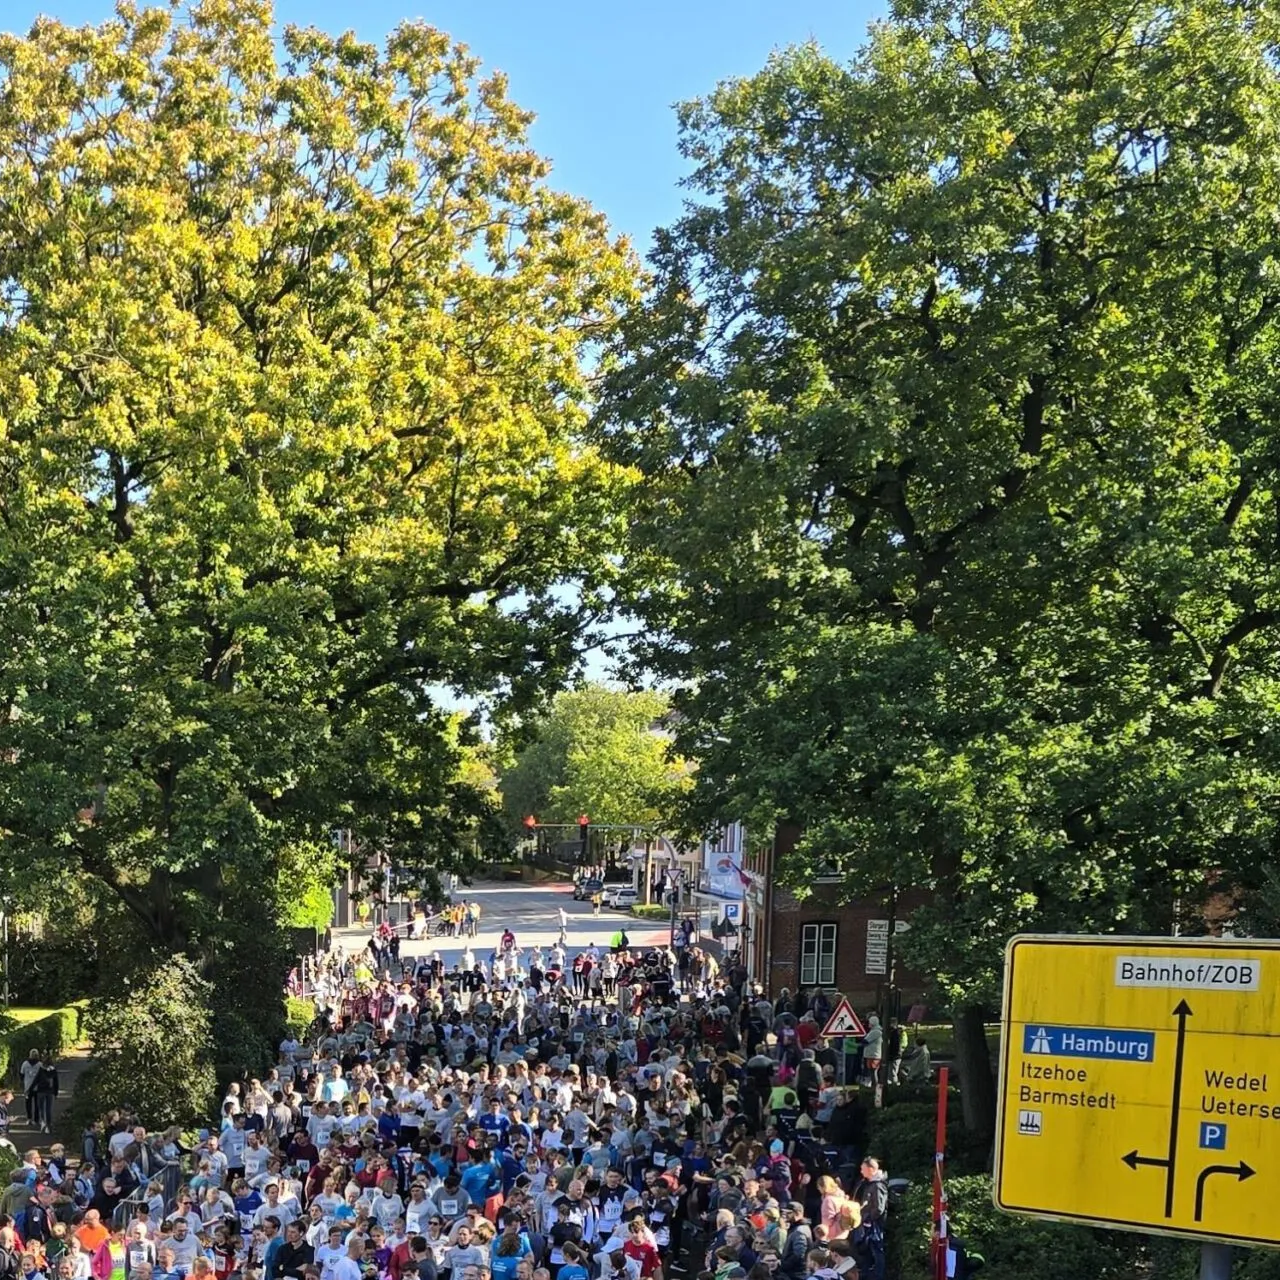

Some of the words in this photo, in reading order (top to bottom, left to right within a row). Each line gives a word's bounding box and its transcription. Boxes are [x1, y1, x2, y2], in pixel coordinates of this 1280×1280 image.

[1121, 962, 1253, 984] Bahnhof/ZOB
[1061, 1032, 1149, 1060] Hamburg
[1020, 1062, 1087, 1082] Itzehoe
[1205, 1069, 1267, 1092] Wedel
[1019, 1085, 1116, 1109] Barmstedt
[1205, 1127, 1220, 1145] P
